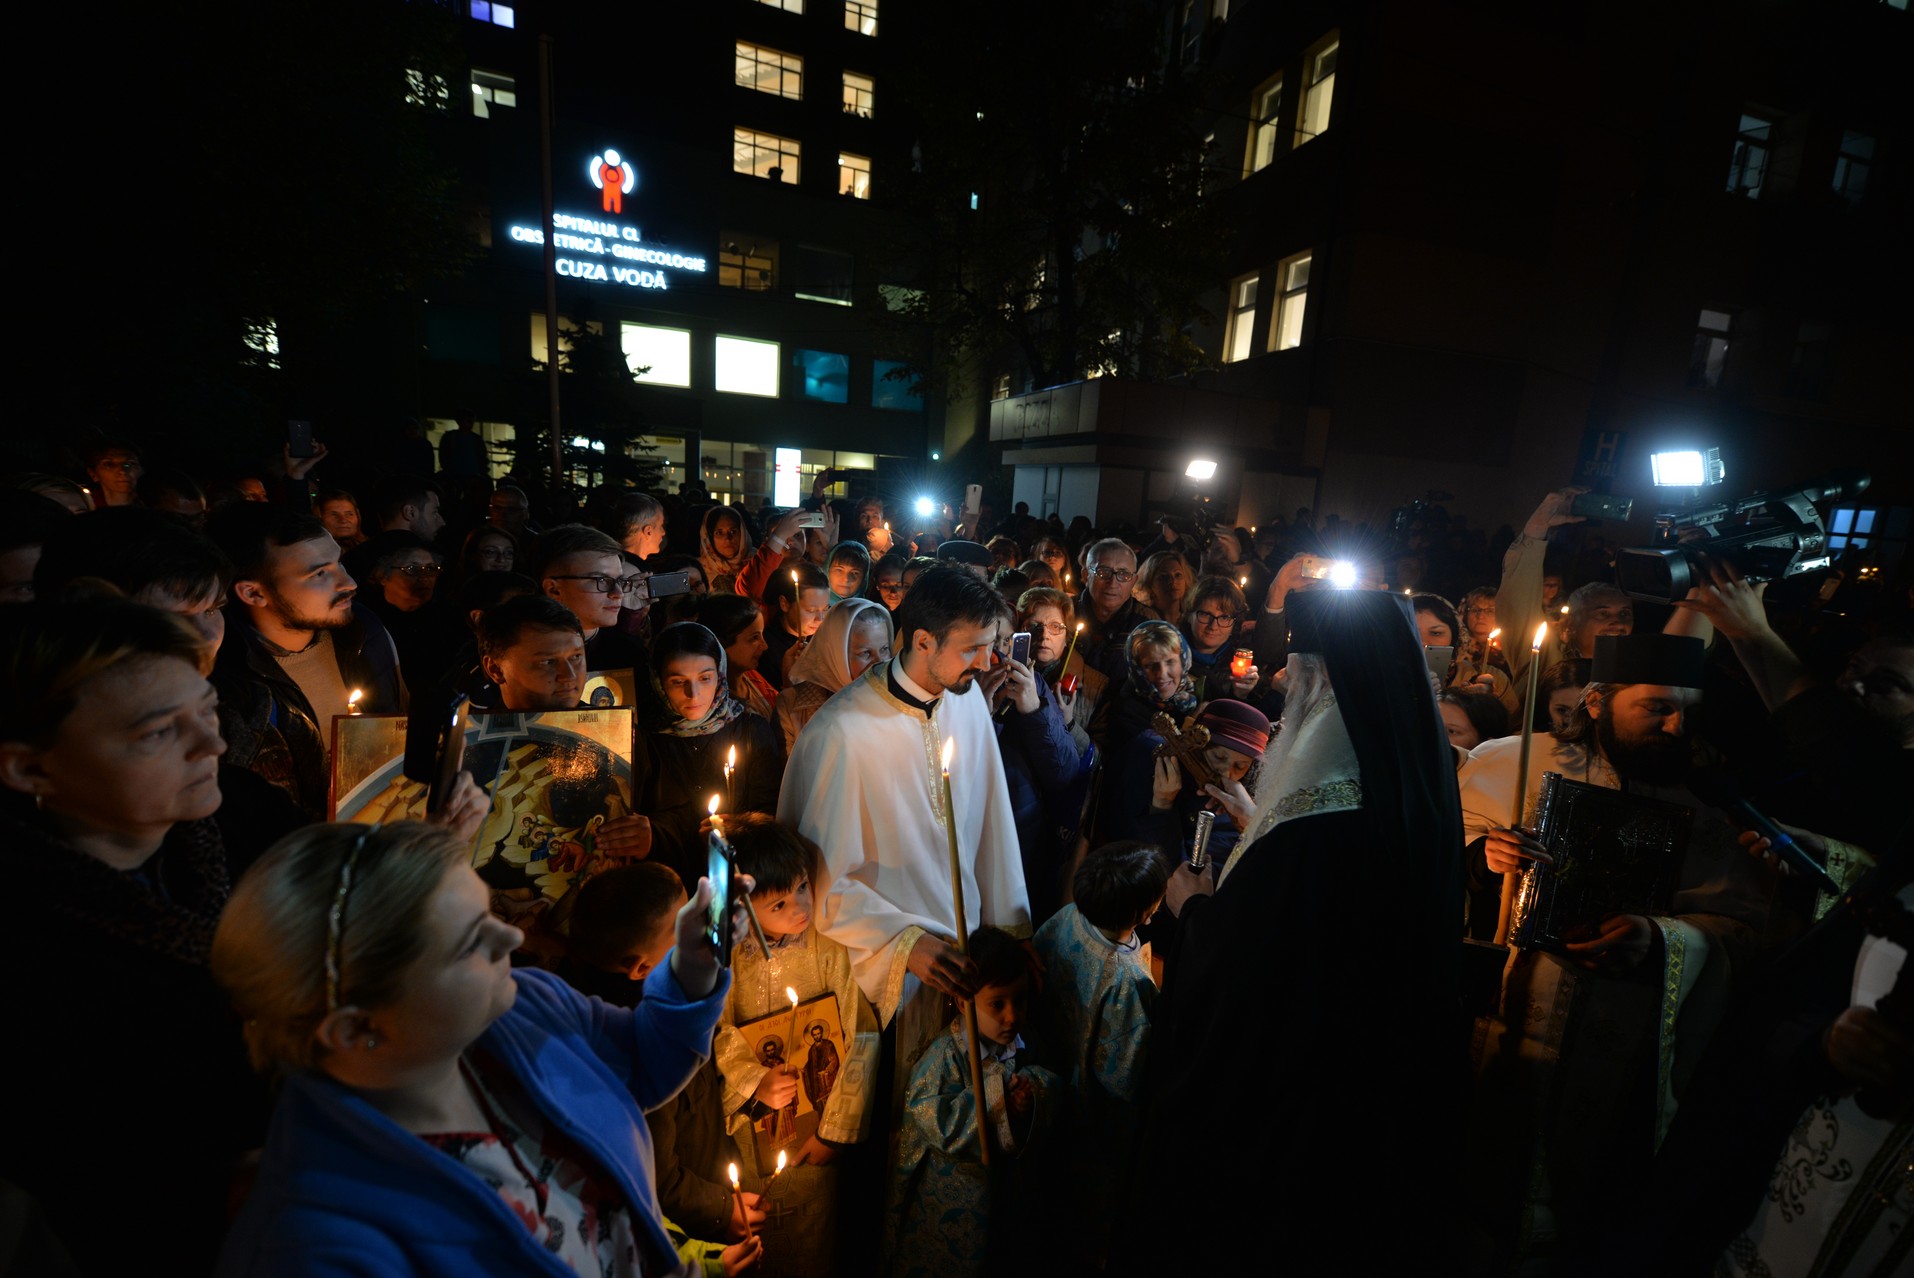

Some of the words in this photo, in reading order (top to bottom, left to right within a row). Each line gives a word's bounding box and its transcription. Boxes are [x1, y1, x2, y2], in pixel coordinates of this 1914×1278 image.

[553, 213, 620, 239] SPITALUL
[555, 258, 608, 281] CUZA
[612, 266, 667, 290] VODĂ
[1594, 432, 1620, 462] H
